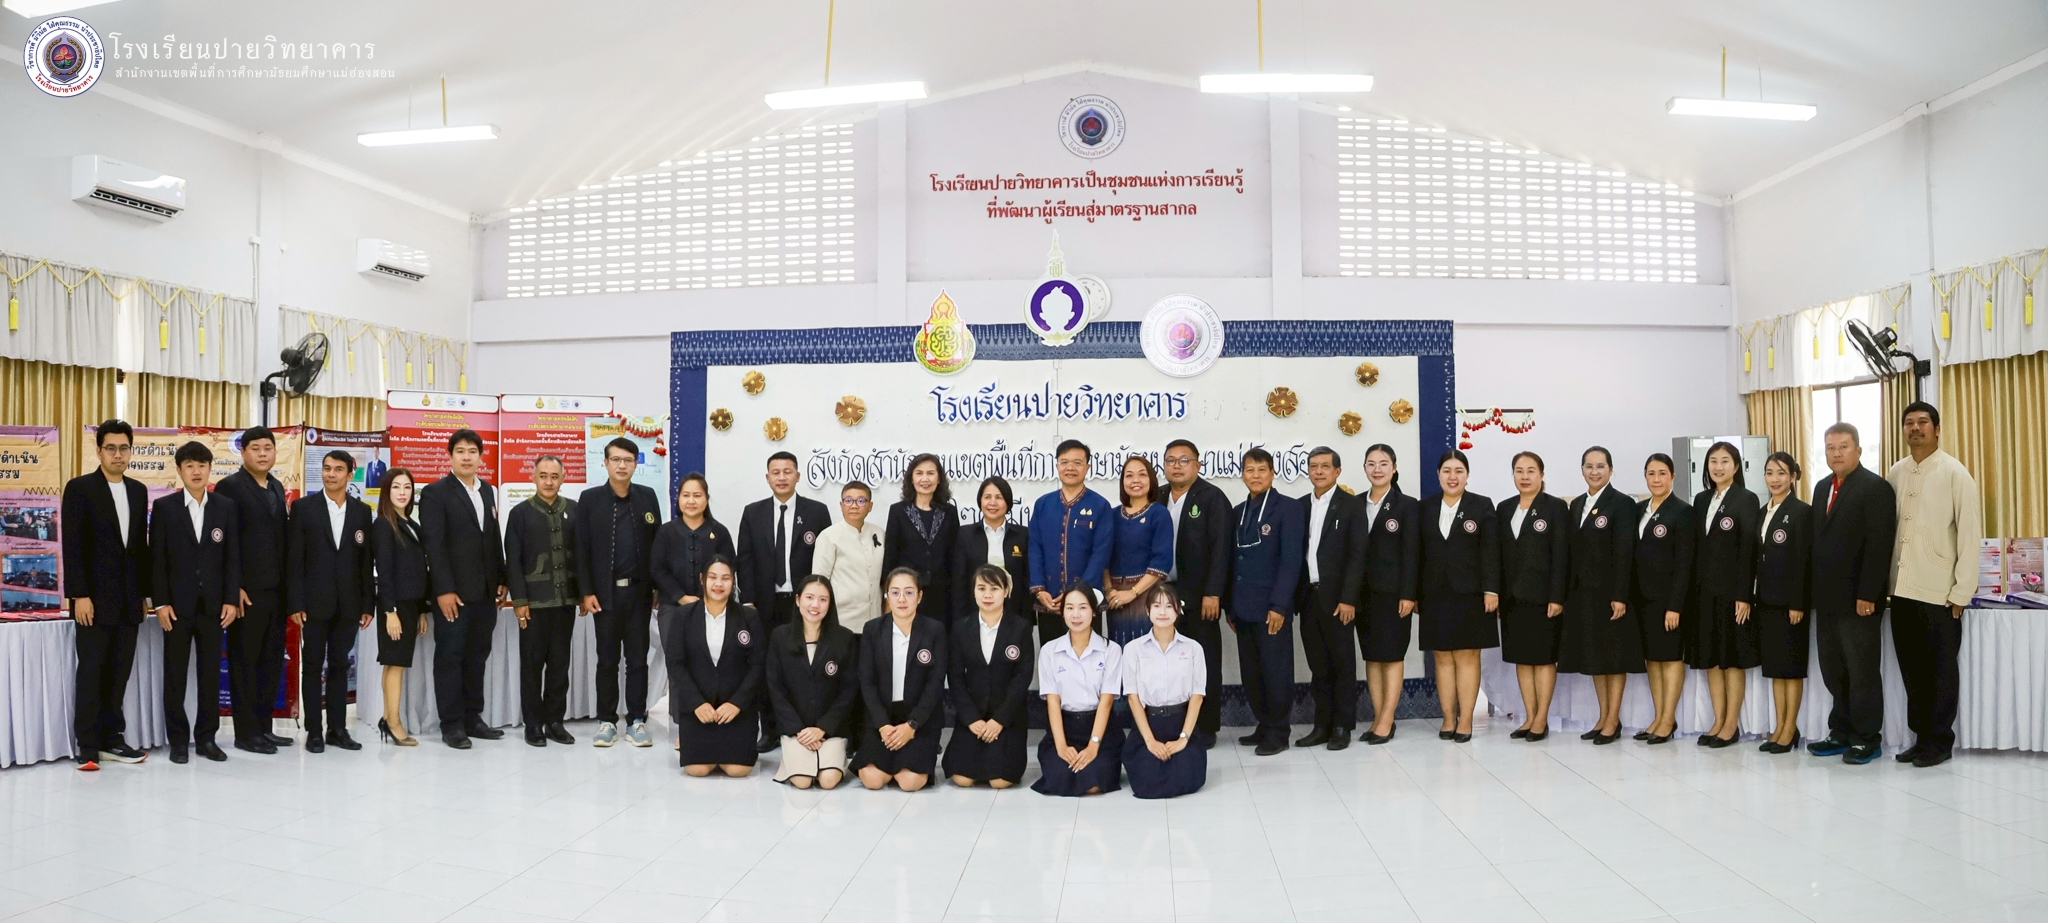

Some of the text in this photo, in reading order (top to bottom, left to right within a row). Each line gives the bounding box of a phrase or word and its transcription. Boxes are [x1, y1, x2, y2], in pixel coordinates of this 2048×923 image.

[986, 195, 1197, 224] ที่พัฒนาผู้เรียนสู่มาตรฐานสากล
[928, 381, 1188, 421] โรงเรียนปายวิทยาคาร
